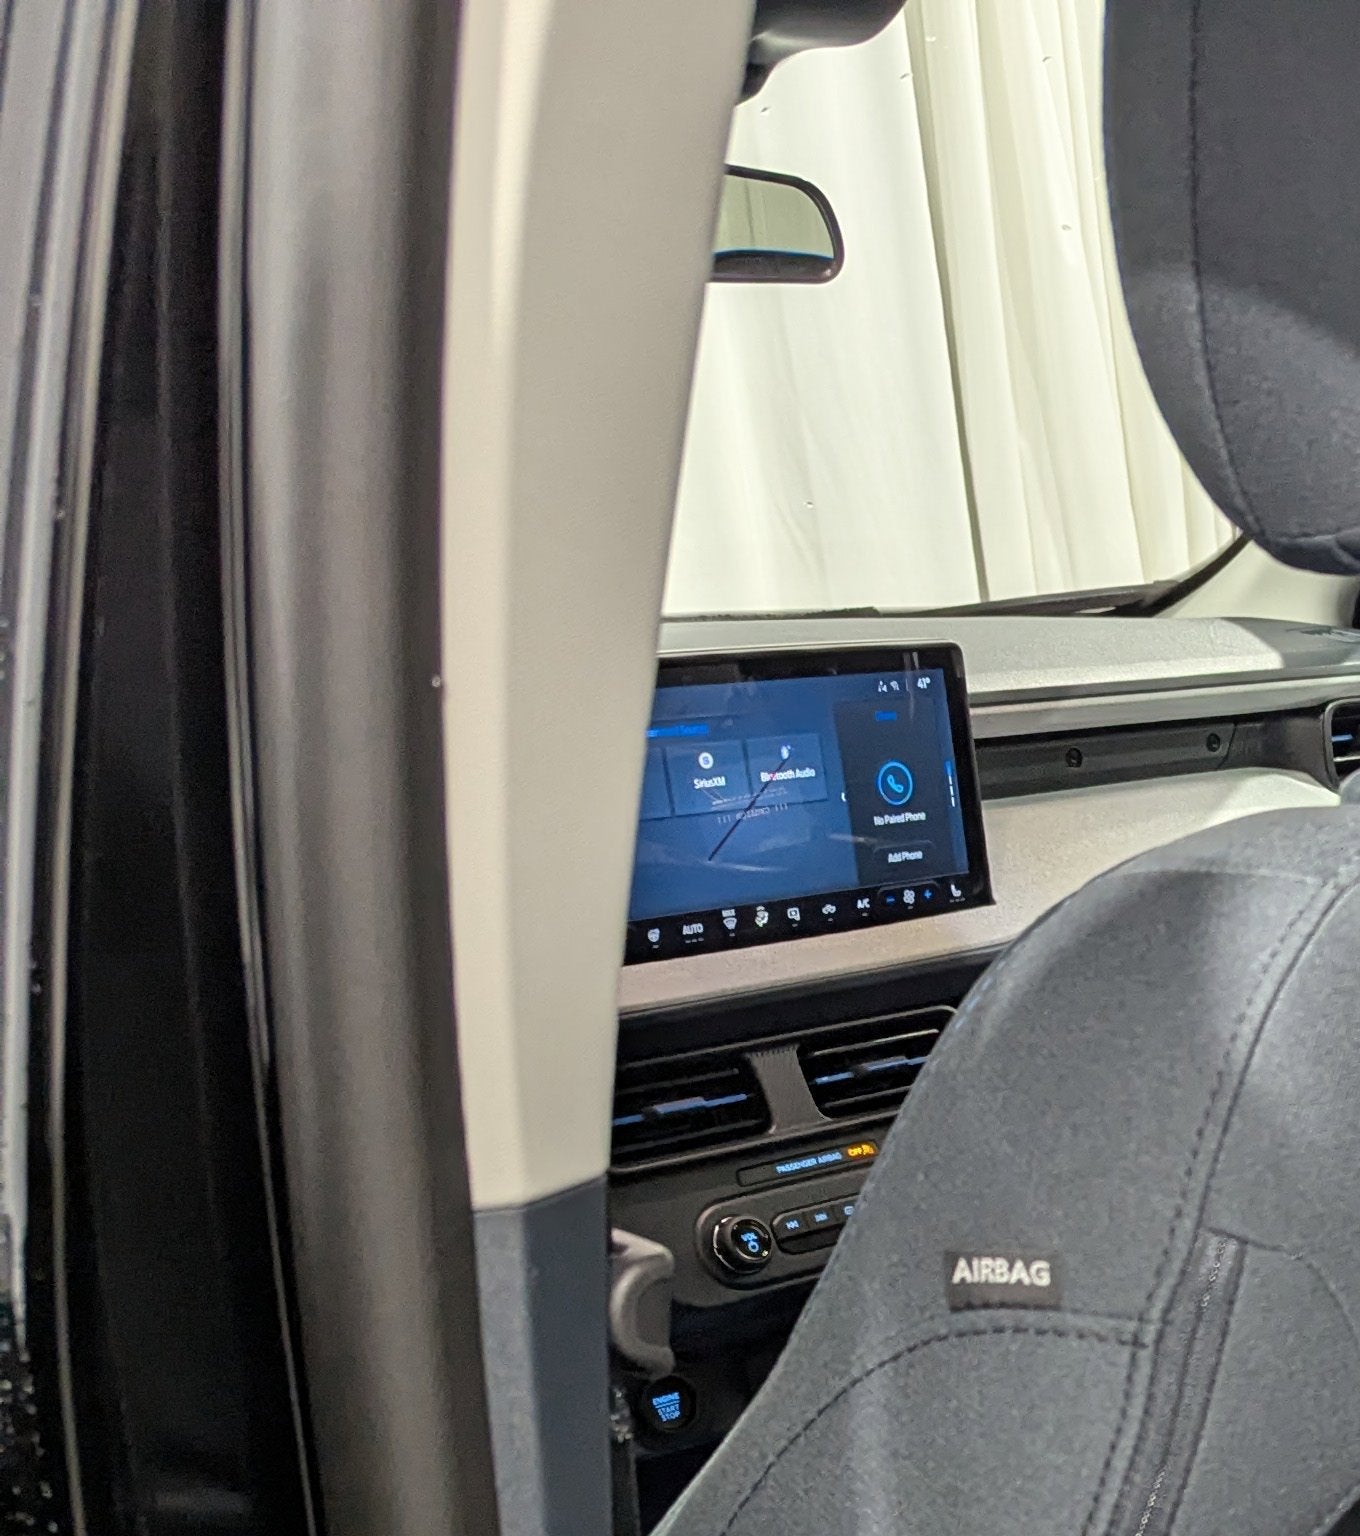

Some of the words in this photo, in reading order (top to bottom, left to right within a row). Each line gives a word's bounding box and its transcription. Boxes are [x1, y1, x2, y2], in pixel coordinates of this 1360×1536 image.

[694, 776, 726, 789] SiriusXM
[905, 811, 926, 822] Phone
[902, 850, 923, 861] Phone
[857, 898, 870, 909] A/C
[682, 923, 704, 935] AUTO
[776, 1157, 817, 1173] PASSENGER
[951, 1256, 1052, 1287] AIRBAG
[652, 1392, 680, 1405] ENGINE
